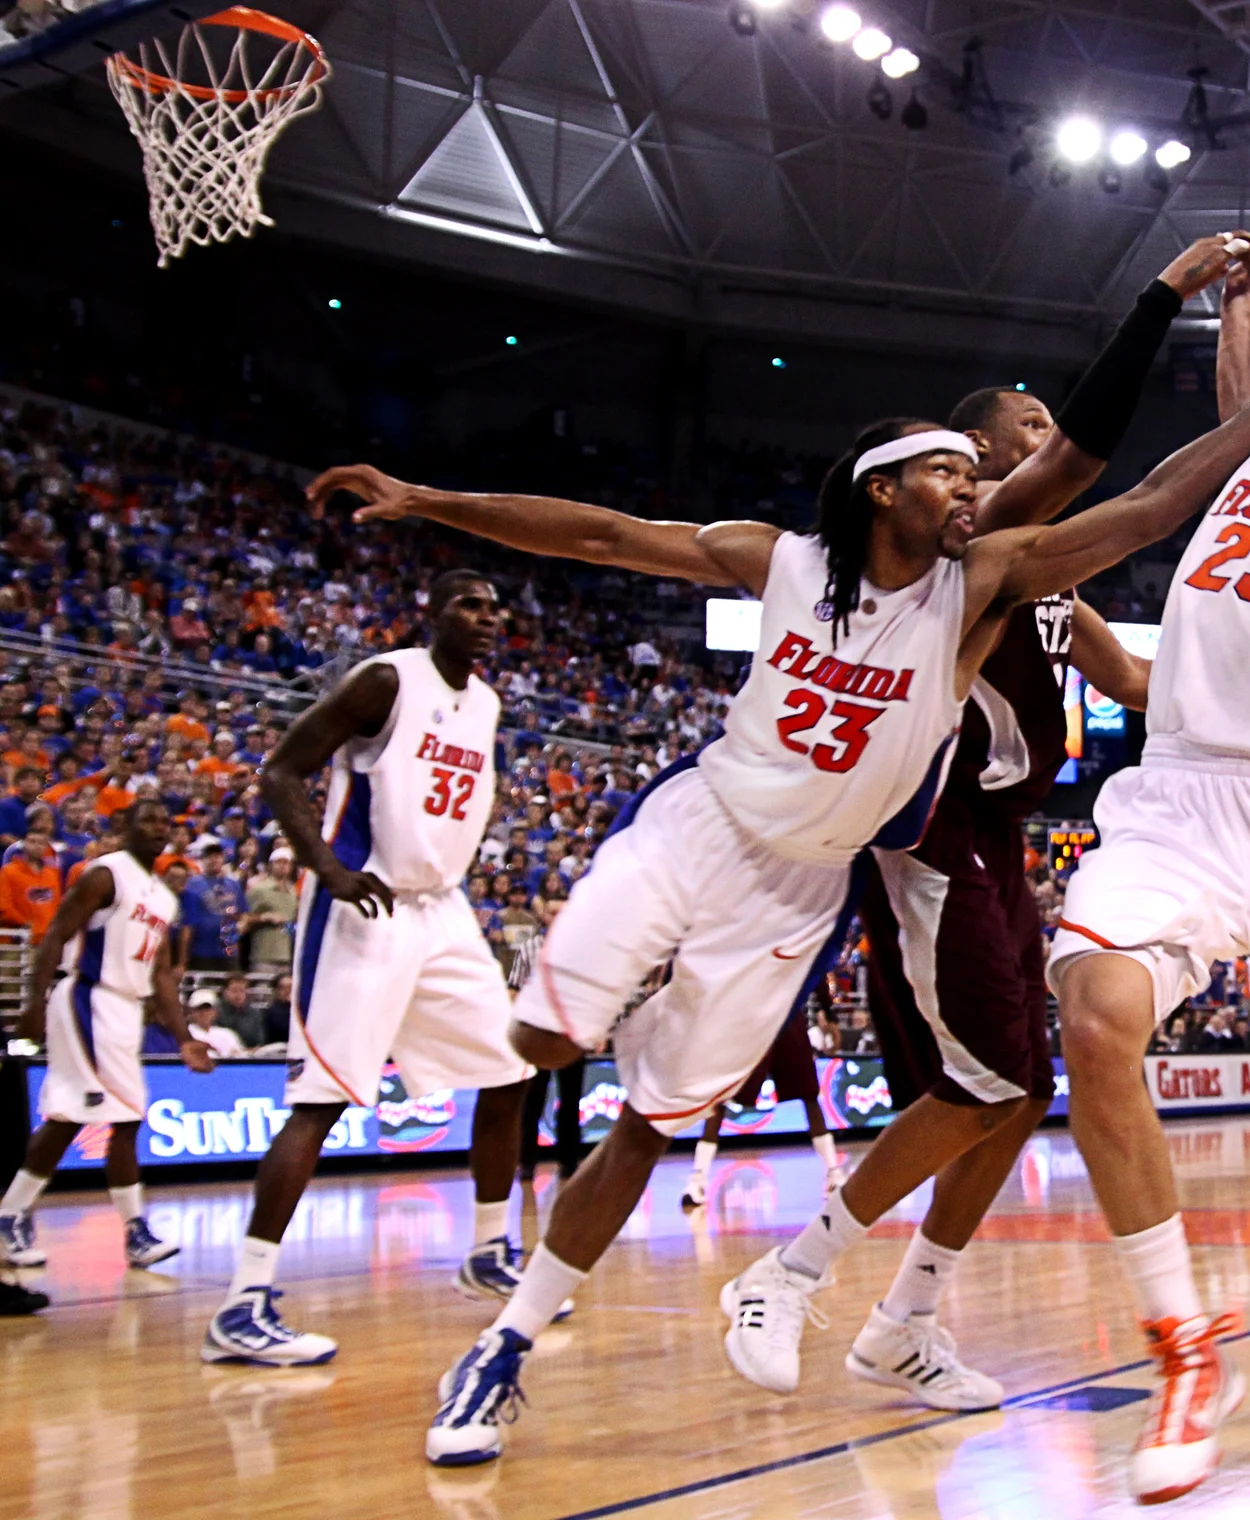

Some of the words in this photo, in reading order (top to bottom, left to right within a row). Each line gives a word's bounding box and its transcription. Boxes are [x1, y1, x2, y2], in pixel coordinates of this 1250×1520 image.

[766, 630, 915, 702] FLORIDA
[776, 688, 888, 773] 23
[423, 767, 475, 821] 32
[1157, 1060, 1222, 1099] GATORS
[147, 1097, 372, 1156] SUNTST
